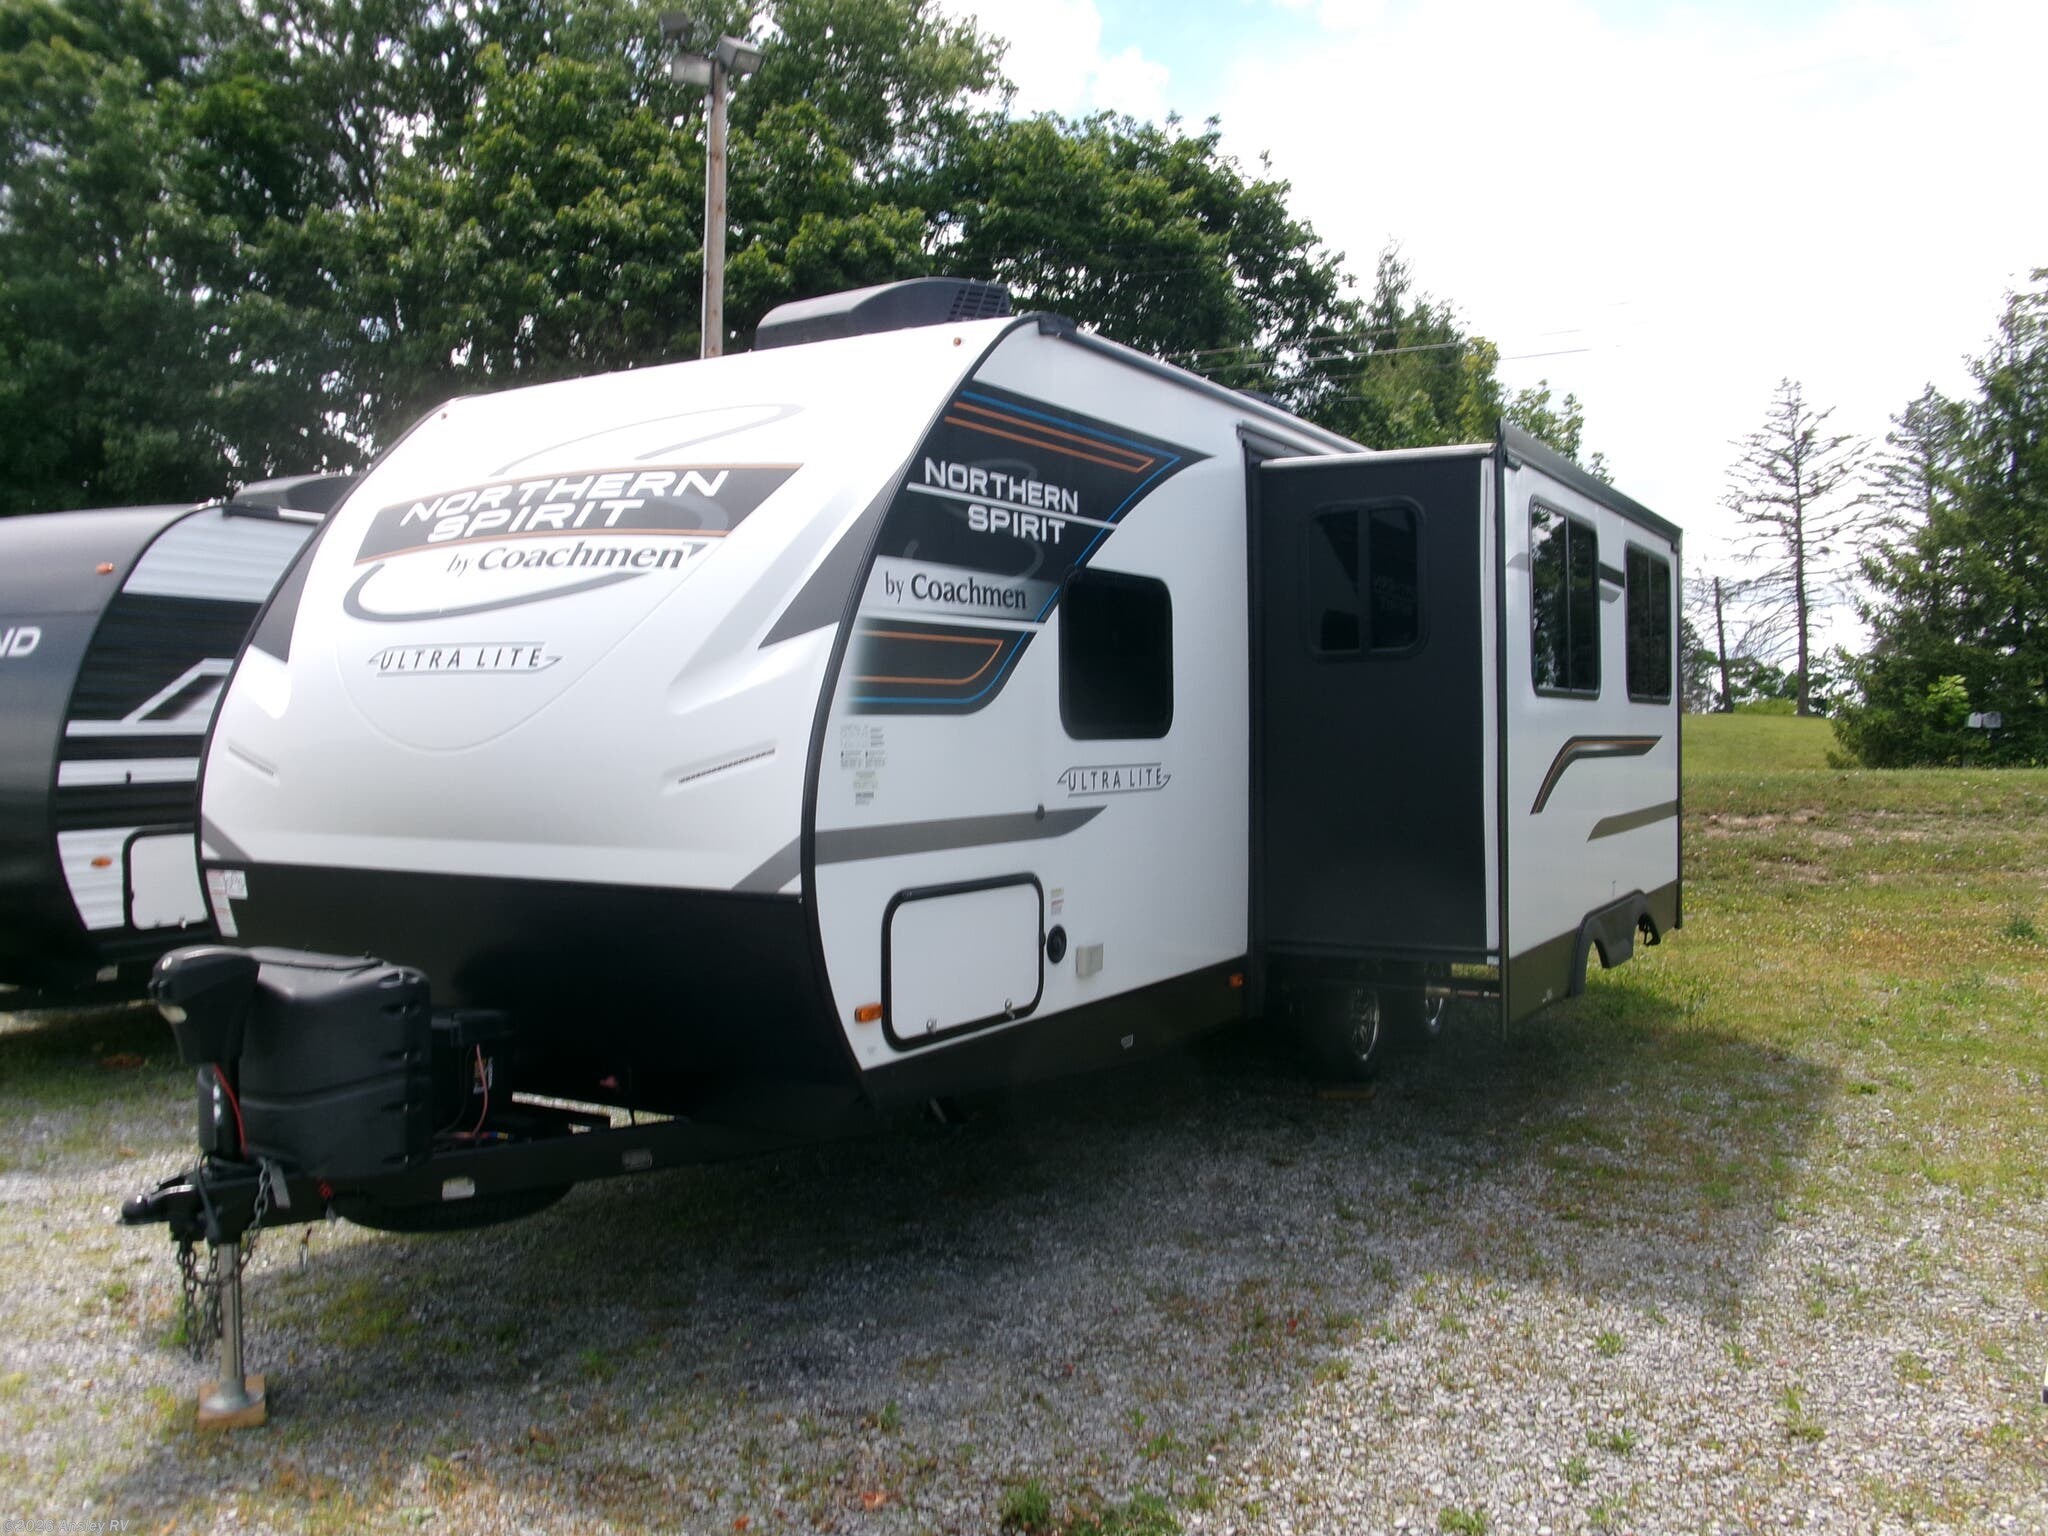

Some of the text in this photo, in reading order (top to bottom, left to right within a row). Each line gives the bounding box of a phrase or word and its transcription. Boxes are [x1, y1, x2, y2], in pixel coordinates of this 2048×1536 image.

[400, 470, 730, 527] NORTHERN
[924, 457, 1079, 515] NORTHERN
[427, 499, 645, 543] SPIRIT
[967, 504, 1066, 544] SPIRIT
[446, 540, 684, 577] by Coachmen
[885, 572, 1027, 610] by Coachmen
[380, 647, 543, 671] ULTRA LITE
[1068, 767, 1162, 792] ULTRA LITE
